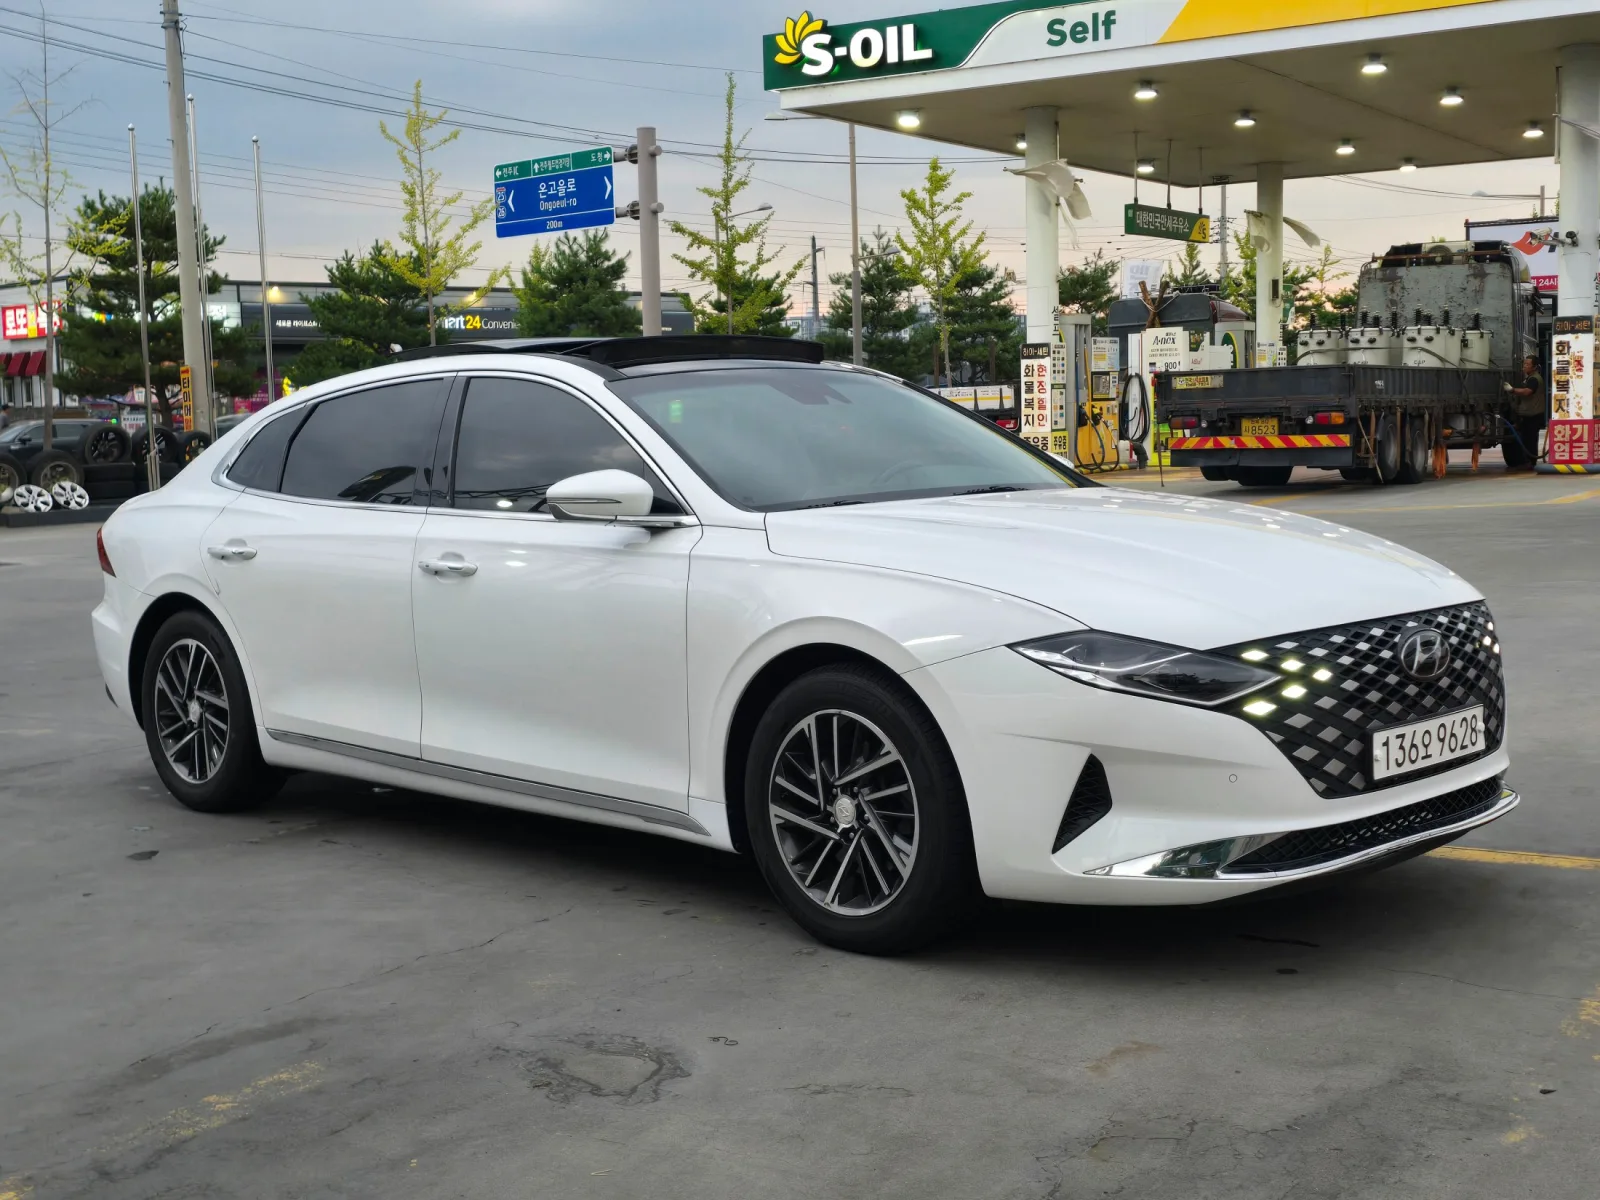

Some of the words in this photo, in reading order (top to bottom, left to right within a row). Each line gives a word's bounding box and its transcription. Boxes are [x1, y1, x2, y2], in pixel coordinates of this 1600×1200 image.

[1046, 10, 1117, 47] Self
[801, 23, 933, 76] S-OIL
[538, 178, 577, 199] 온고을로
[539, 197, 577, 212] Ongoeul-ro
[546, 220, 563, 230] 200m
[1136, 210, 1190, 234] 대한민국만세주유소
[6, 307, 28, 337] 로또
[1023, 363, 1035, 427] 화물복지
[1553, 424, 1589, 442] 화기
[1553, 442, 1589, 460] 엄금
[1381, 729, 1433, 771] 136오
[1436, 713, 1478, 757] 9628
